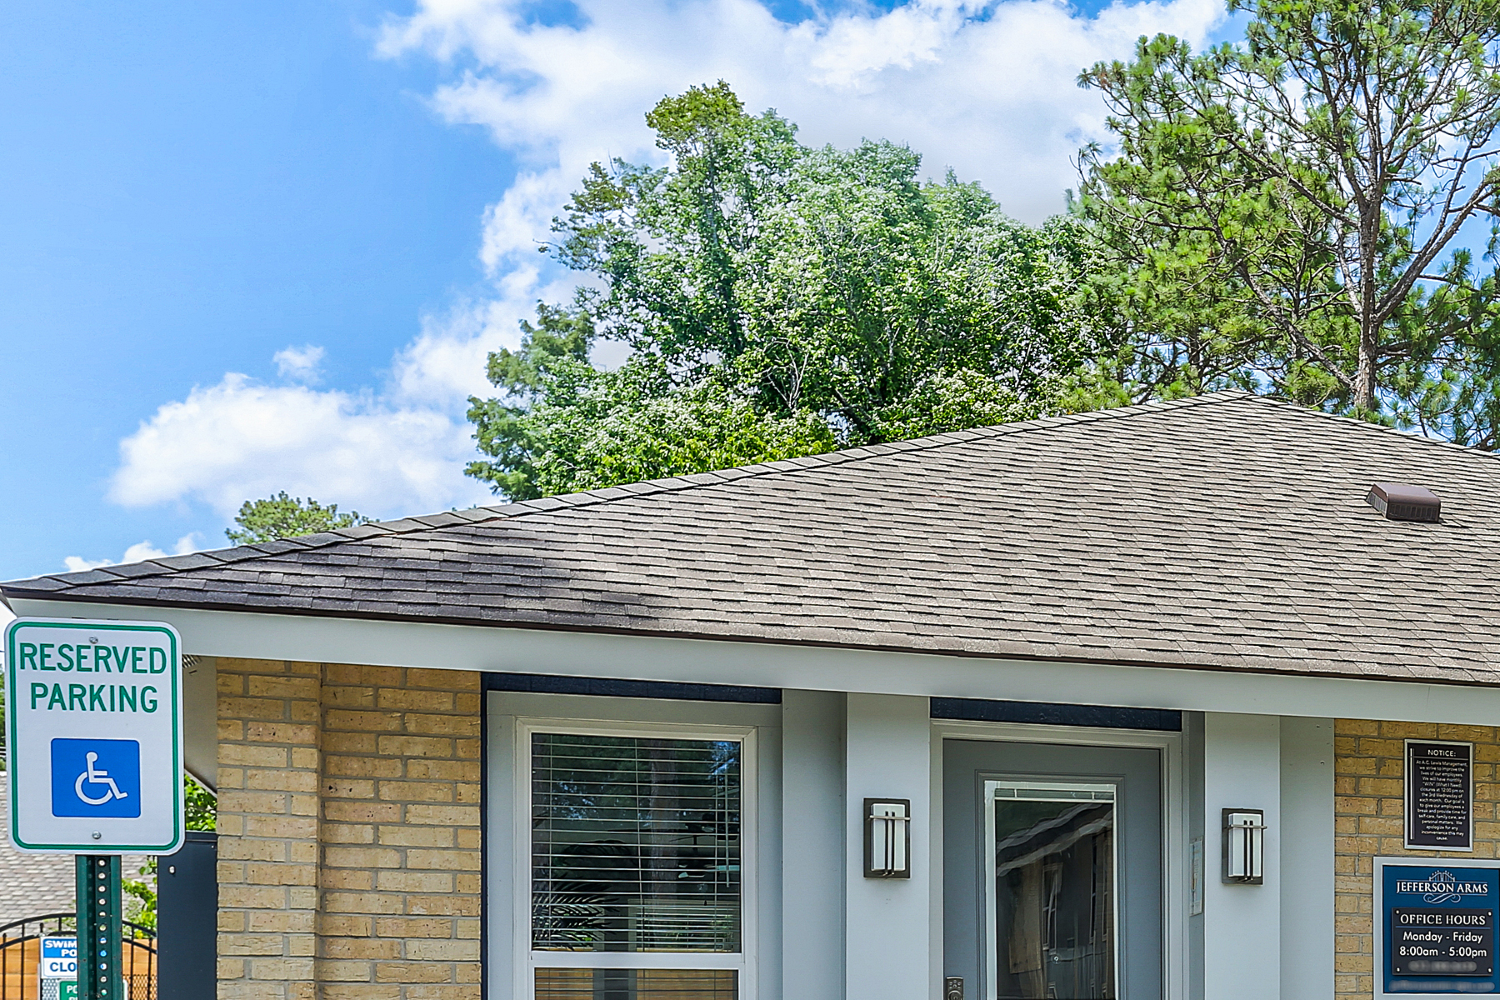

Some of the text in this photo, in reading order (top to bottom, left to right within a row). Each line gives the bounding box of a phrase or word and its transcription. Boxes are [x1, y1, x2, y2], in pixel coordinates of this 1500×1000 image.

[19, 642, 167, 675] RESERVED
[30, 682, 158, 714] PARKING
[1427, 749, 1457, 757] NOTICE:
[1396, 881, 1488, 893] JEFFERSON ARMS
[1400, 913, 1486, 925] OFFICE HOURS
[1402, 931, 1443, 944] Monday
[1452, 931, 1483, 944] Friday
[1399, 945, 1439, 956] 8:00am
[1448, 946, 1488, 959] 5:00pm
